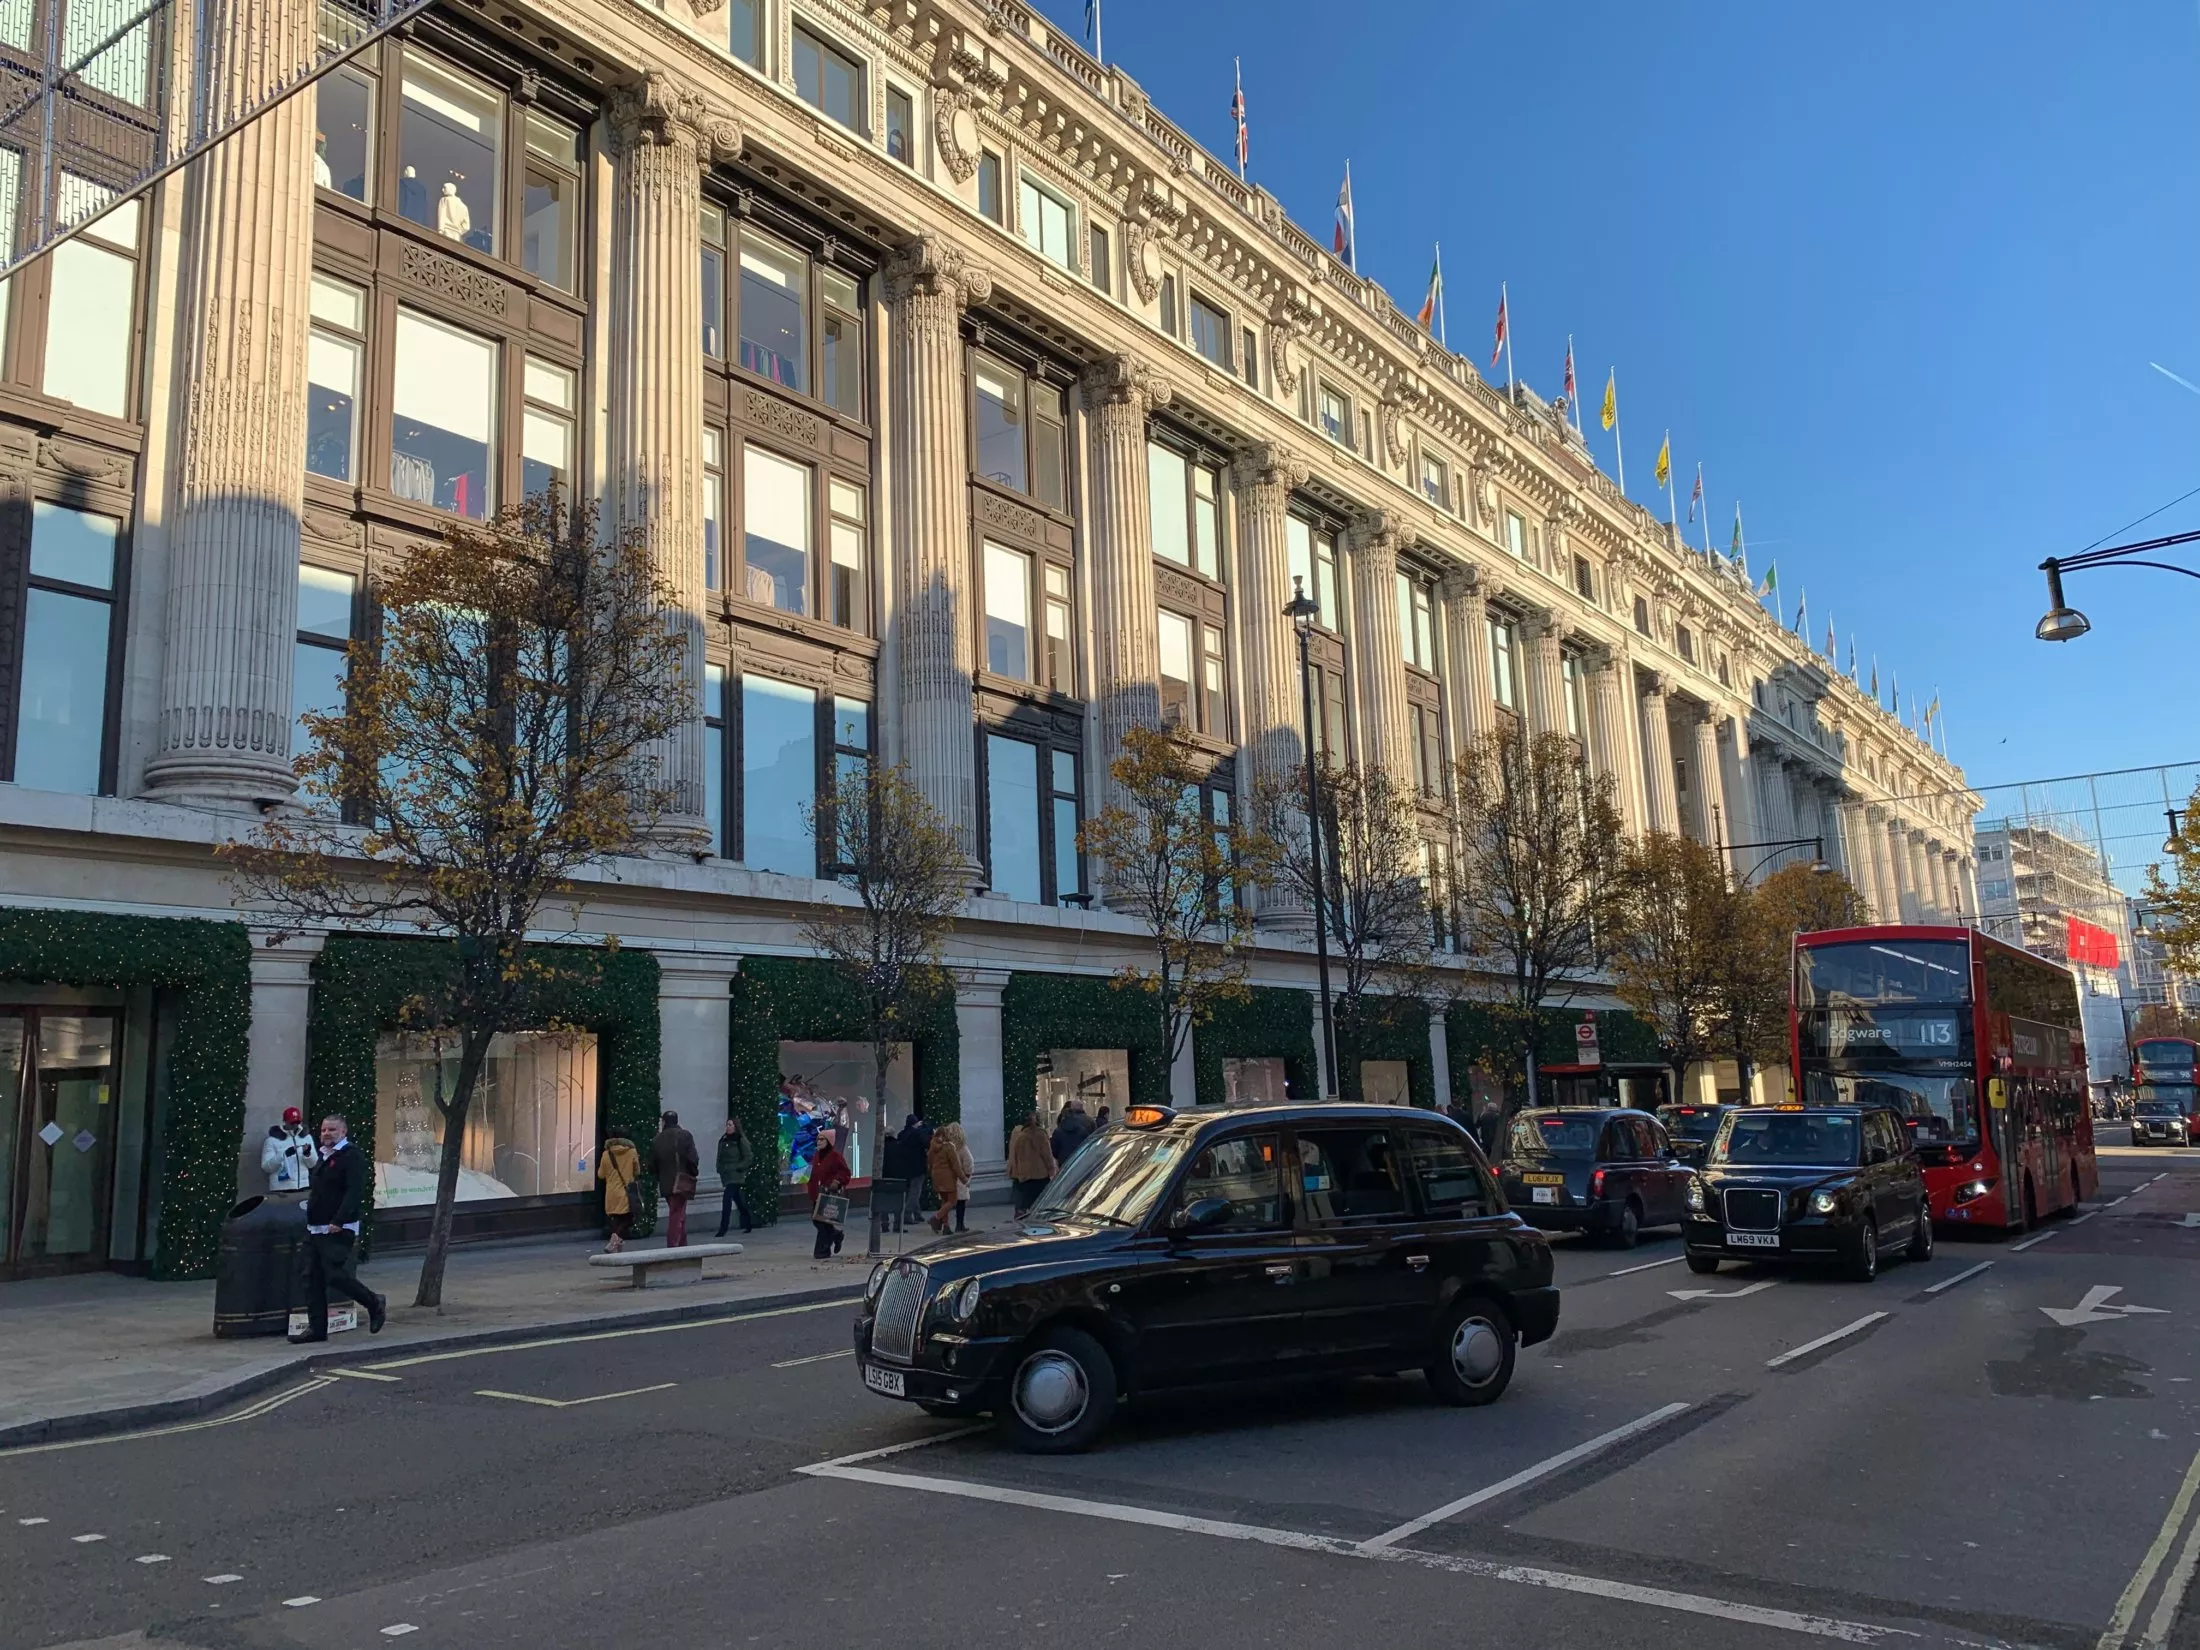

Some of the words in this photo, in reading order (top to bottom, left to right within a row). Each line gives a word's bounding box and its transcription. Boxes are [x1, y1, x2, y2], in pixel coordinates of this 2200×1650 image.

[1829, 1026, 1892, 1042] Edgware
[1920, 1023, 1951, 1044] 113
[1730, 1235, 1755, 1245] LM69
[1757, 1235, 1776, 1245] VKA
[868, 1366, 883, 1387] LS15
[884, 1372, 900, 1392] GBX
